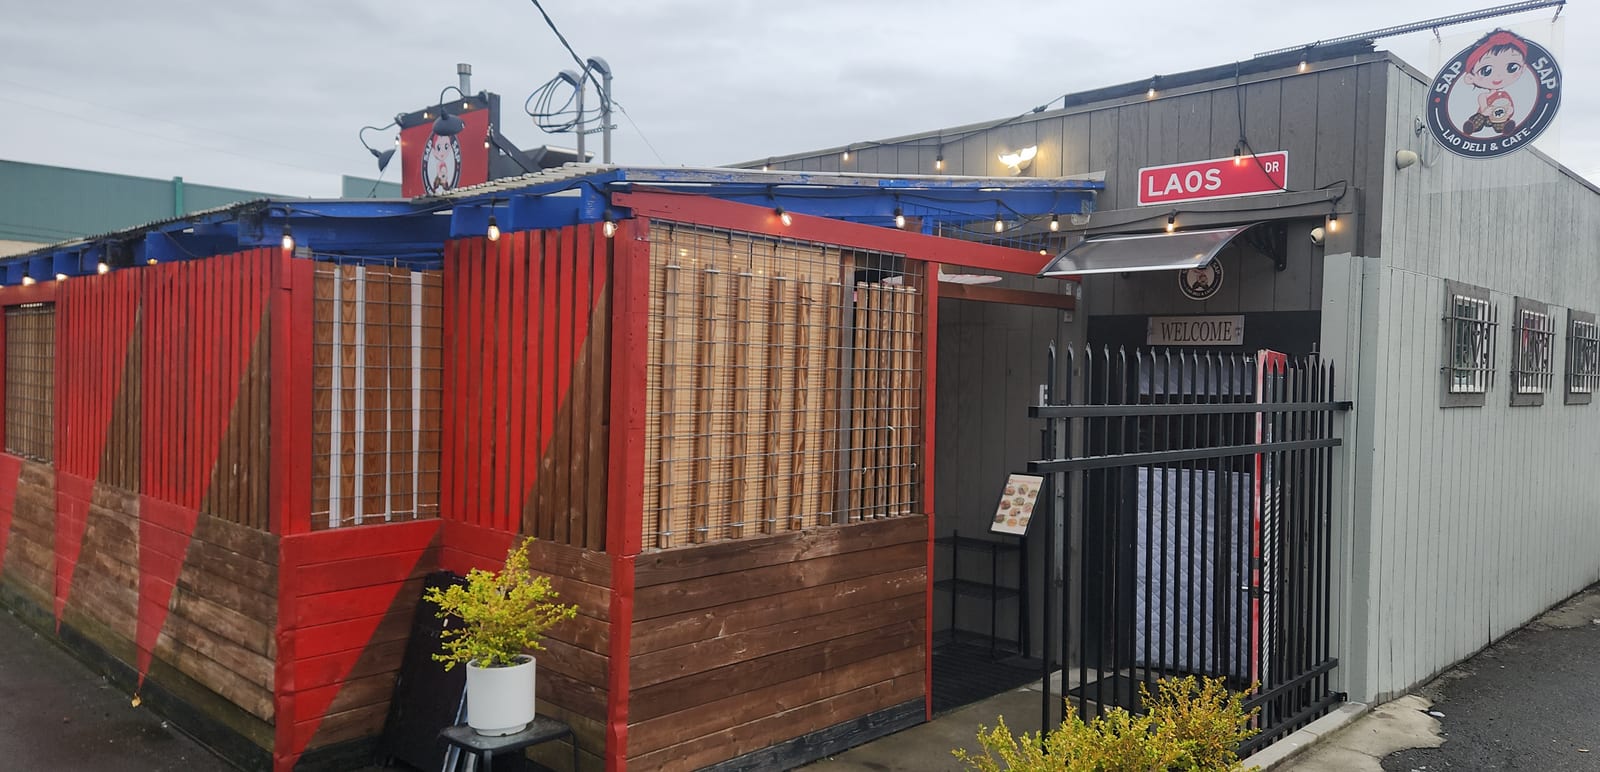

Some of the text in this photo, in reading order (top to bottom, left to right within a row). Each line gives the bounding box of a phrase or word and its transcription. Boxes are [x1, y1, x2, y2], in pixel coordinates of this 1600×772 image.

[1436, 56, 1556, 94] SAP SAP
[1442, 127, 1531, 152] LAO DELI & CAFE
[1148, 161, 1279, 197] LAOS DR
[1161, 321, 1232, 342] WELCOME
